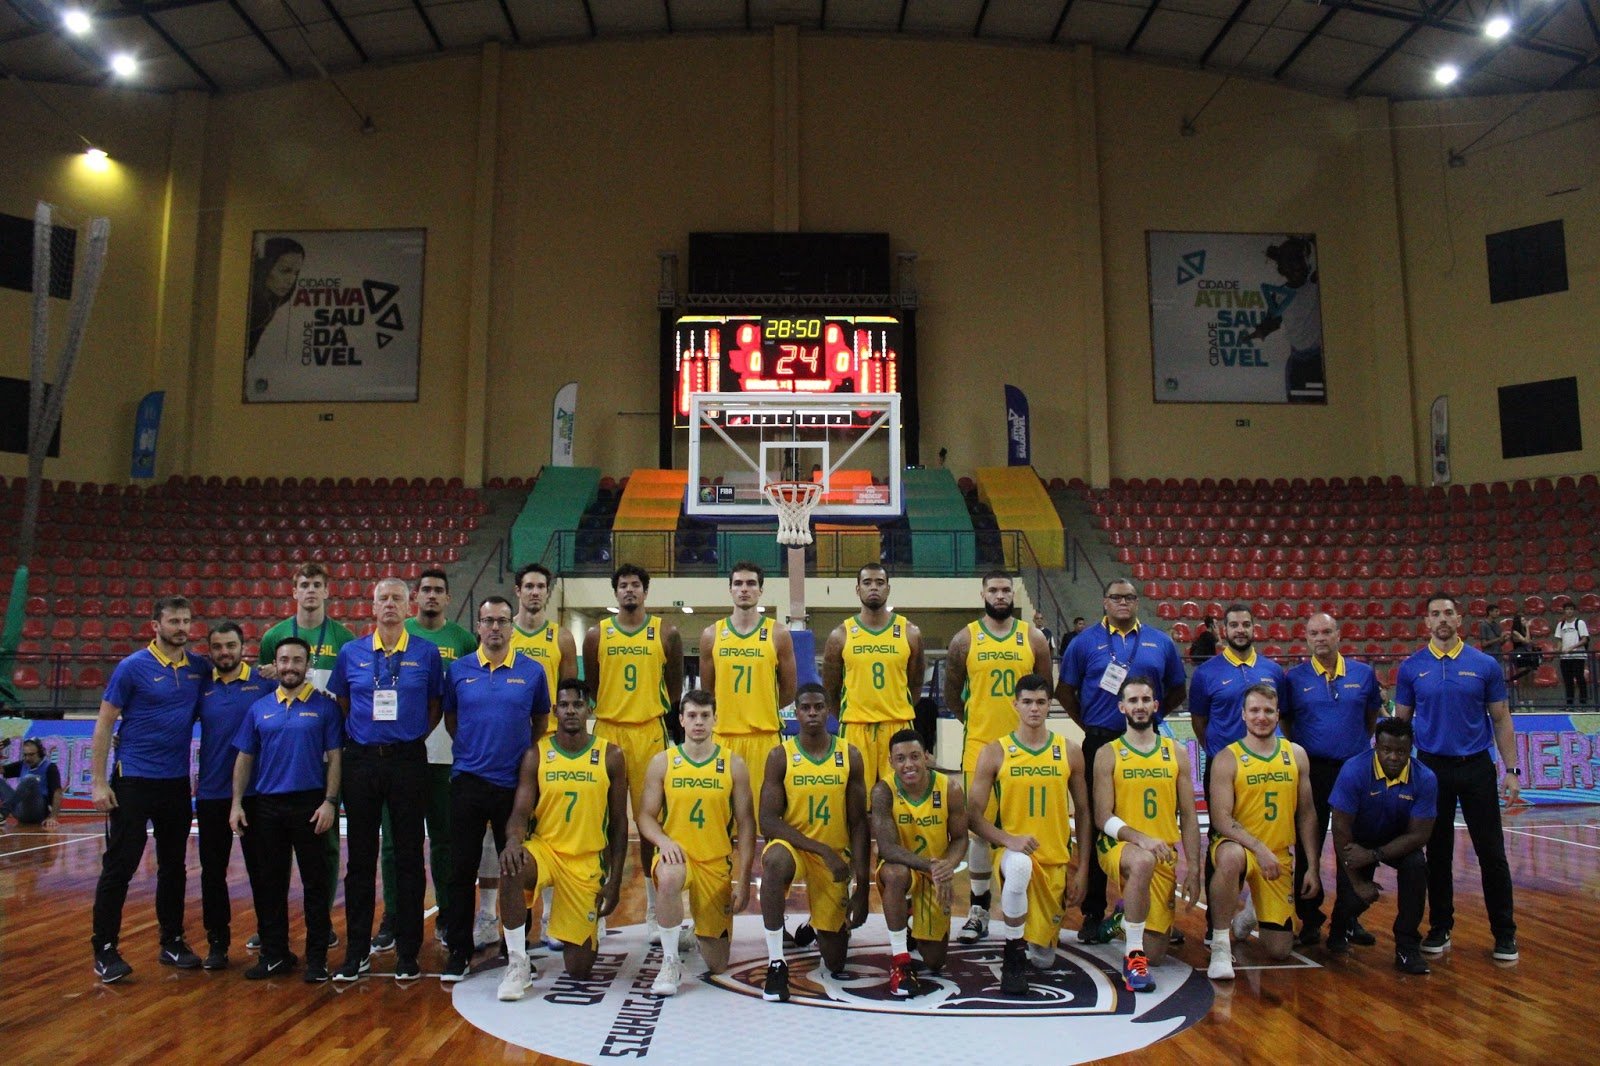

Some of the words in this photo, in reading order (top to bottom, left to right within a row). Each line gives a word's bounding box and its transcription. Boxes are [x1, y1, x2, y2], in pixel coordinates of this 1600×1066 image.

[298, 278, 341, 287] CIDADE
[1198, 280, 1239, 289] CIDADE
[293, 288, 365, 306] ATIVA
[1195, 290, 1264, 308] ATIVA
[314, 308, 365, 326] SAU
[1217, 310, 1265, 328] SAU
[765, 319, 821, 338] 28:50
[1208, 322, 1219, 366] CIDADE
[313, 348, 362, 366] VEL
[776, 345, 819, 374] 24
[1219, 348, 1269, 367] VEL
[607, 646, 652, 655] BRASIL
[719, 648, 764, 657] BRASIL
[853, 645, 899, 654] BRASIL
[977, 651, 1023, 661] BRASIL
[624, 664, 637, 691] 9
[732, 665, 752, 693] 71
[872, 662, 885, 689] 8
[990, 669, 1016, 696] 20
[546, 770, 597, 782] BRASIL
[793, 774, 844, 785] BRASIL
[1010, 766, 1062, 776] BRASIL
[1123, 768, 1173, 779] BRASIL
[1246, 772, 1293, 785] BRASIL
[672, 778, 724, 789] BRASIL
[565, 791, 578, 823] 7
[808, 795, 831, 826] 14
[1029, 786, 1047, 817] 11
[1143, 788, 1157, 819] 6
[1264, 791, 1278, 821] 5
[689, 799, 705, 829] 4
[912, 835, 927, 854] 2
